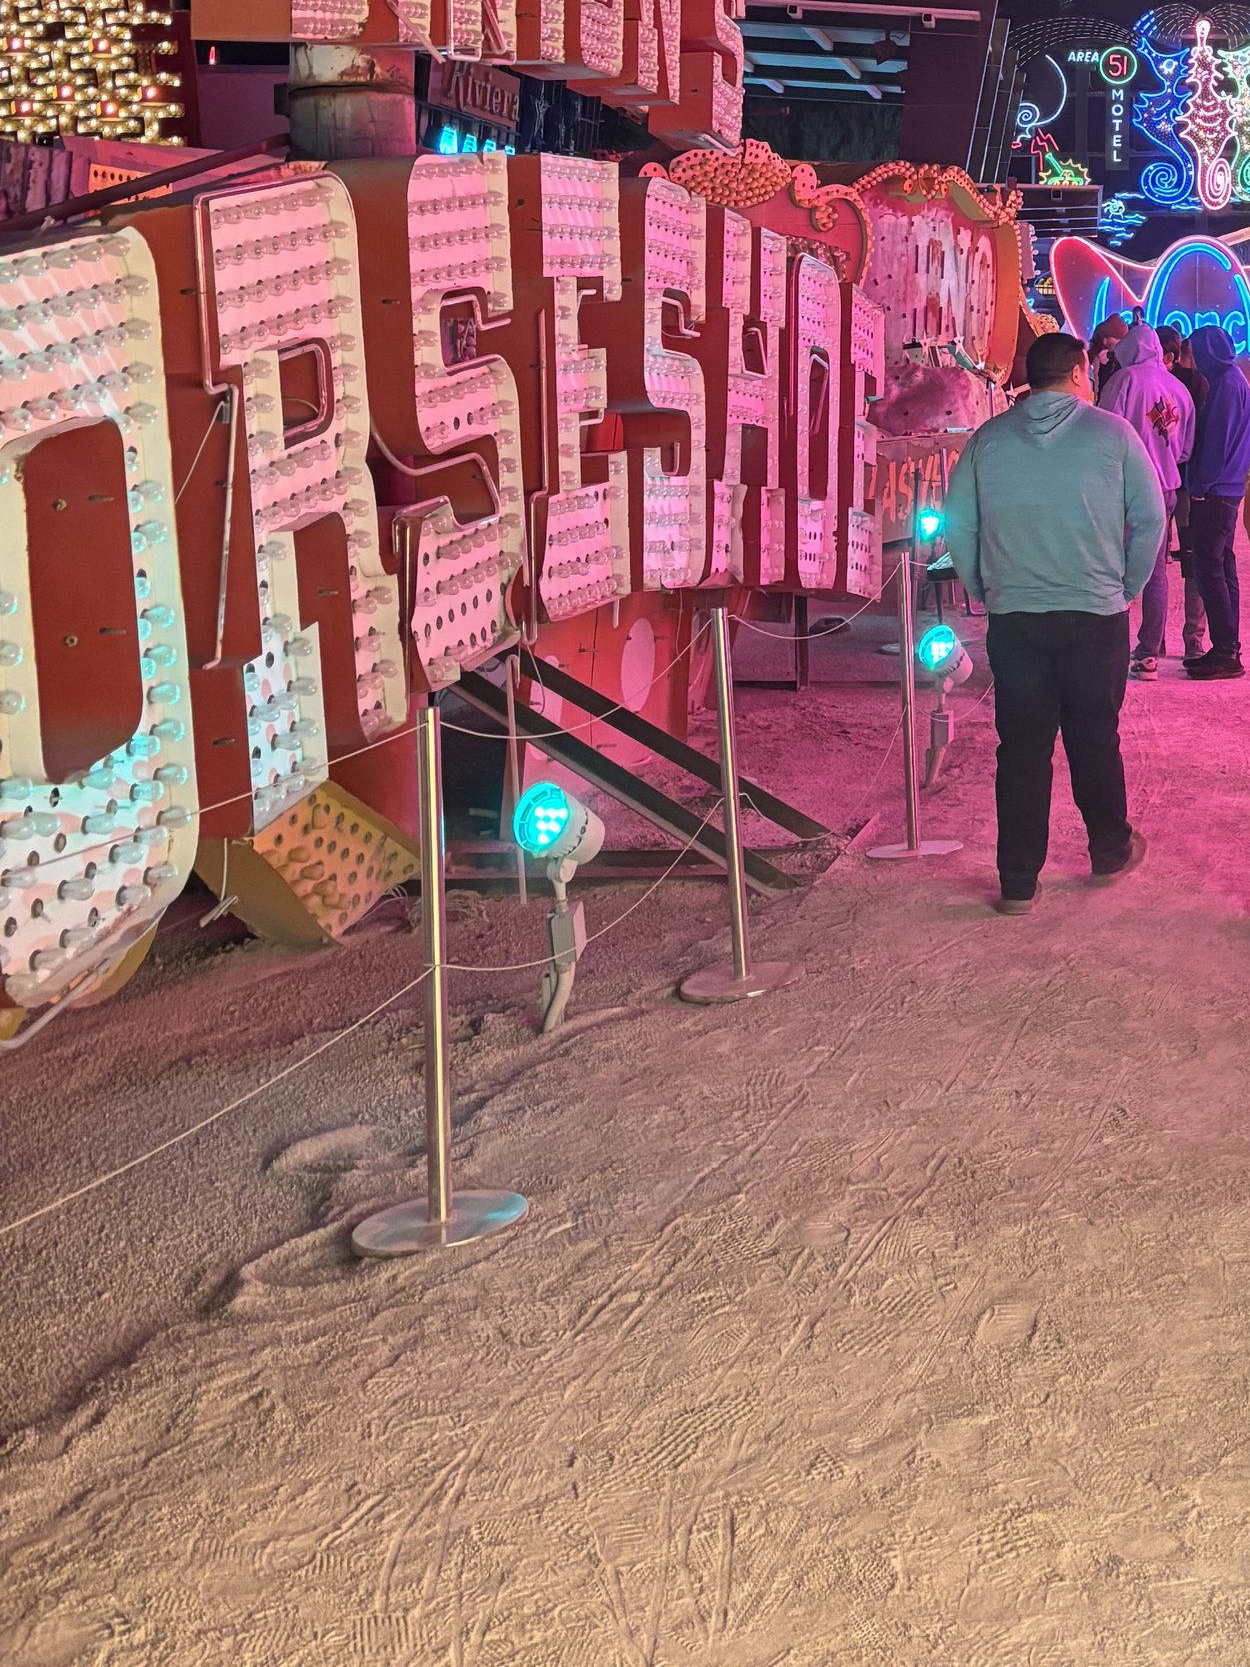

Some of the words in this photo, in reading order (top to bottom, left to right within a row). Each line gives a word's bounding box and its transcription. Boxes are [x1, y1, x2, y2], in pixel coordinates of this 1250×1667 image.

[446, 61, 521, 123] Riviera
[1067, 50, 1100, 63] AREA
[1108, 54, 1128, 77] 51
[1111, 89, 1124, 163] MOTEL
[0, 152, 886, 1007] ORSESHOE
